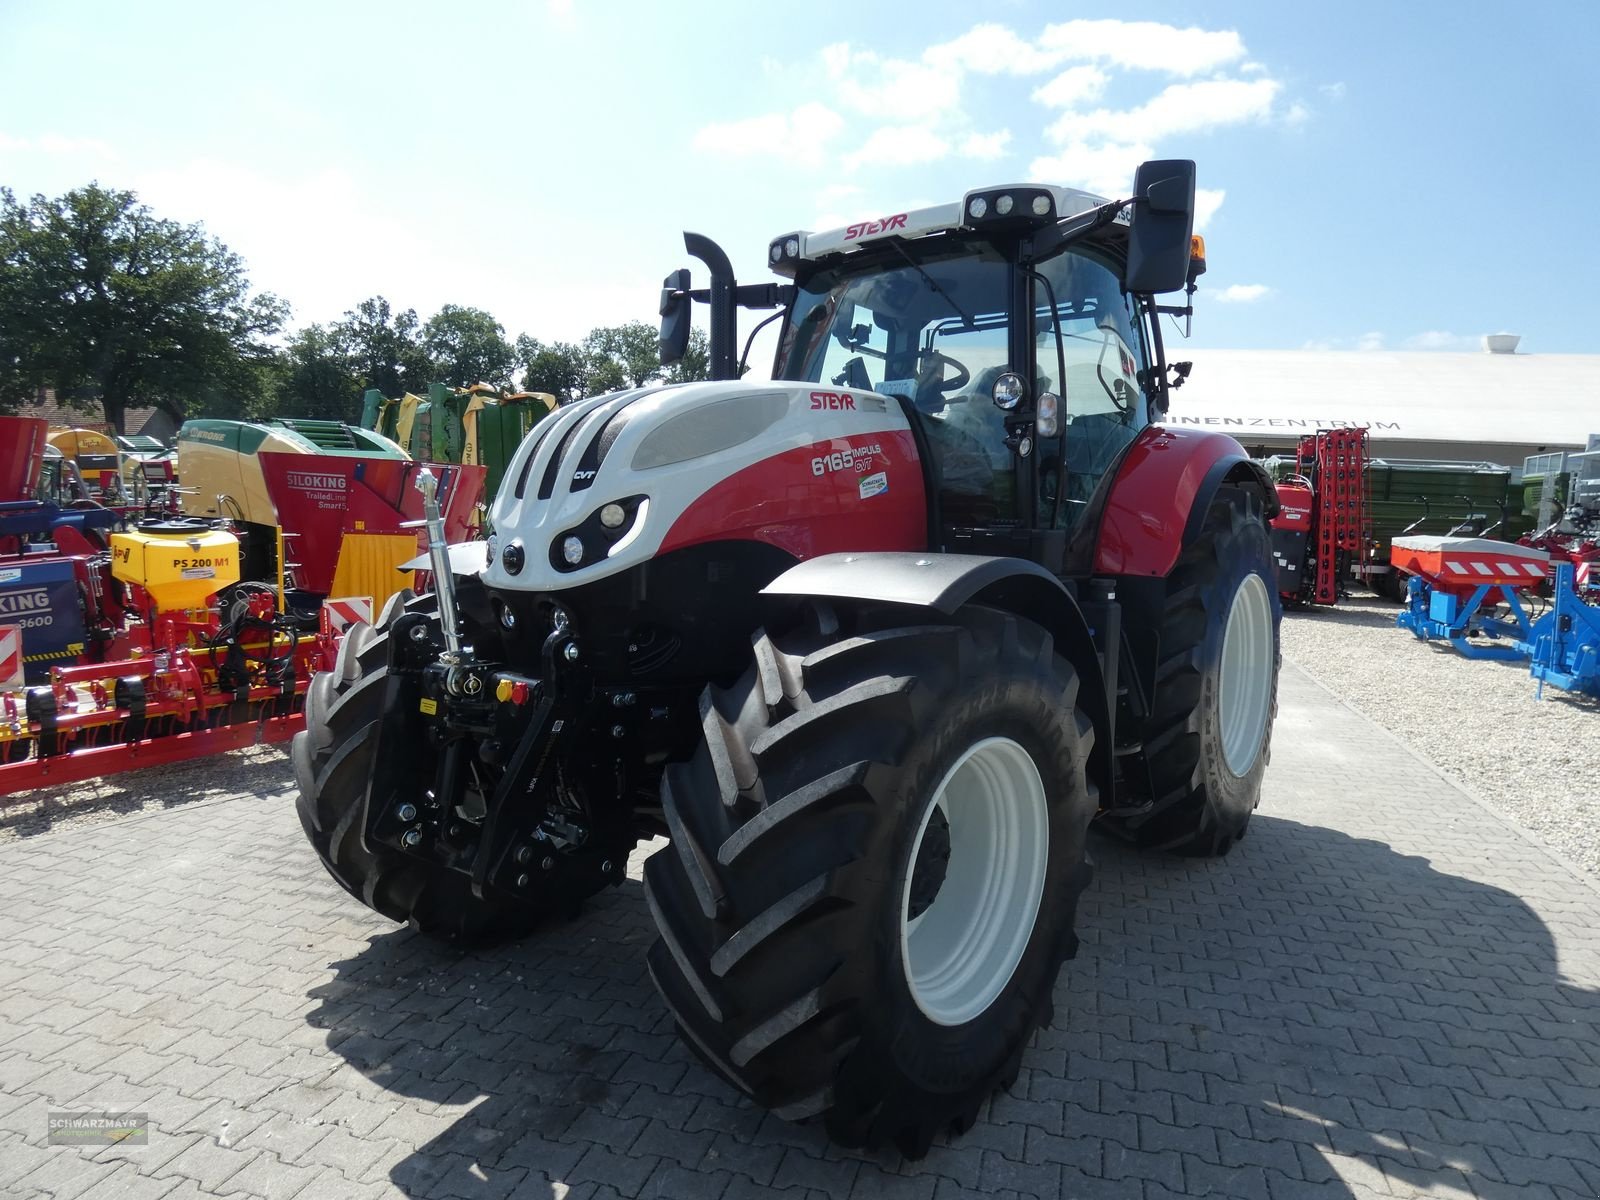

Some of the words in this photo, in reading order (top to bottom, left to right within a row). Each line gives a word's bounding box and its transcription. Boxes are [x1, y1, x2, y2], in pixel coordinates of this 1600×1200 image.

[844, 213, 908, 240] STEYR
[810, 391, 856, 411] STEYR
[811, 450, 854, 476] 6165
[852, 444, 881, 458] IMPULS
[855, 457, 872, 473] CVT
[287, 474, 346, 489] SILOKING
[573, 470, 596, 480] CVT
[173, 559, 188, 568] PS
[192, 559, 211, 567] 200
[214, 558, 229, 567] M1
[19, 615, 53, 629] 3600
